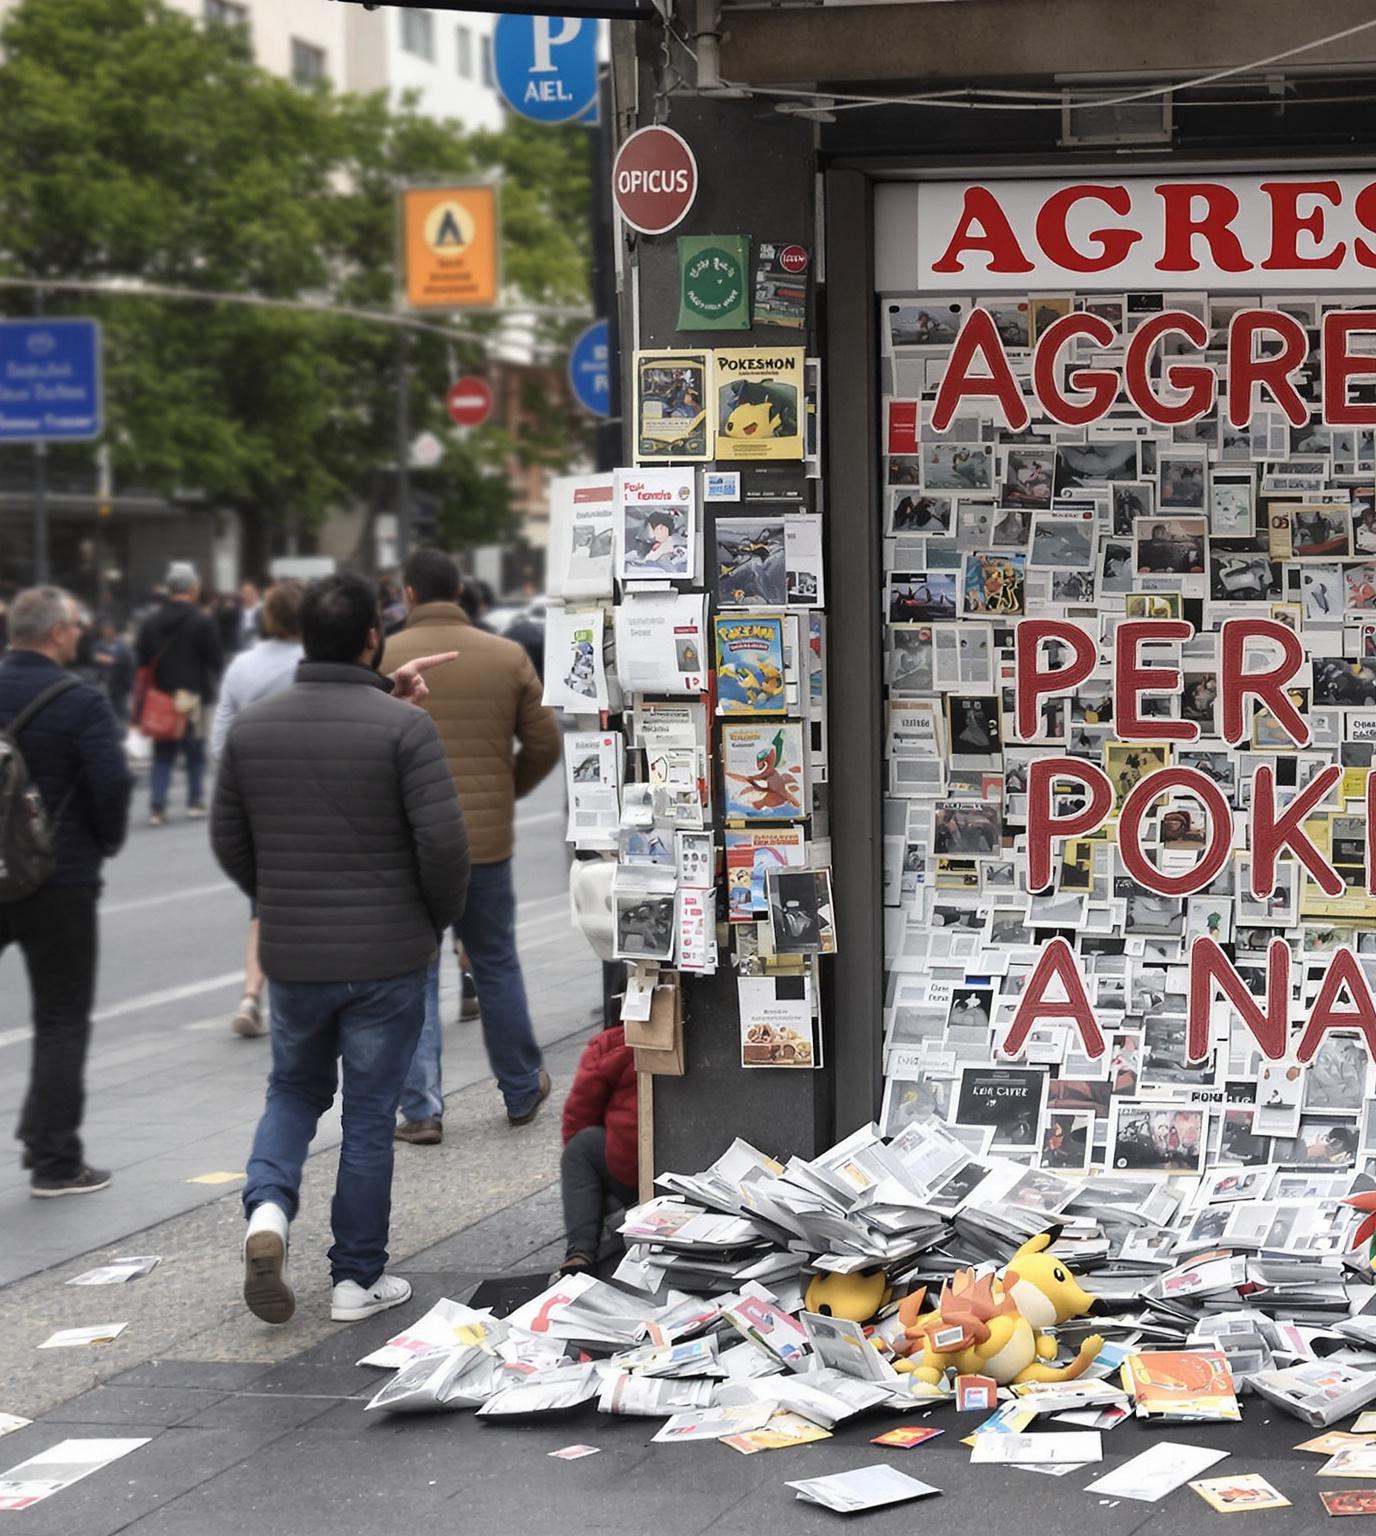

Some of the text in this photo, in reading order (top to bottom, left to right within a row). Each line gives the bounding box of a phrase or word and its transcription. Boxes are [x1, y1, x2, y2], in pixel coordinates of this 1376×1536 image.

[528, 15, 583, 73] P
[618, 169, 689, 194] OPICUS
[1017, 618, 1309, 744] PER
[1003, 939, 1106, 1058] A
